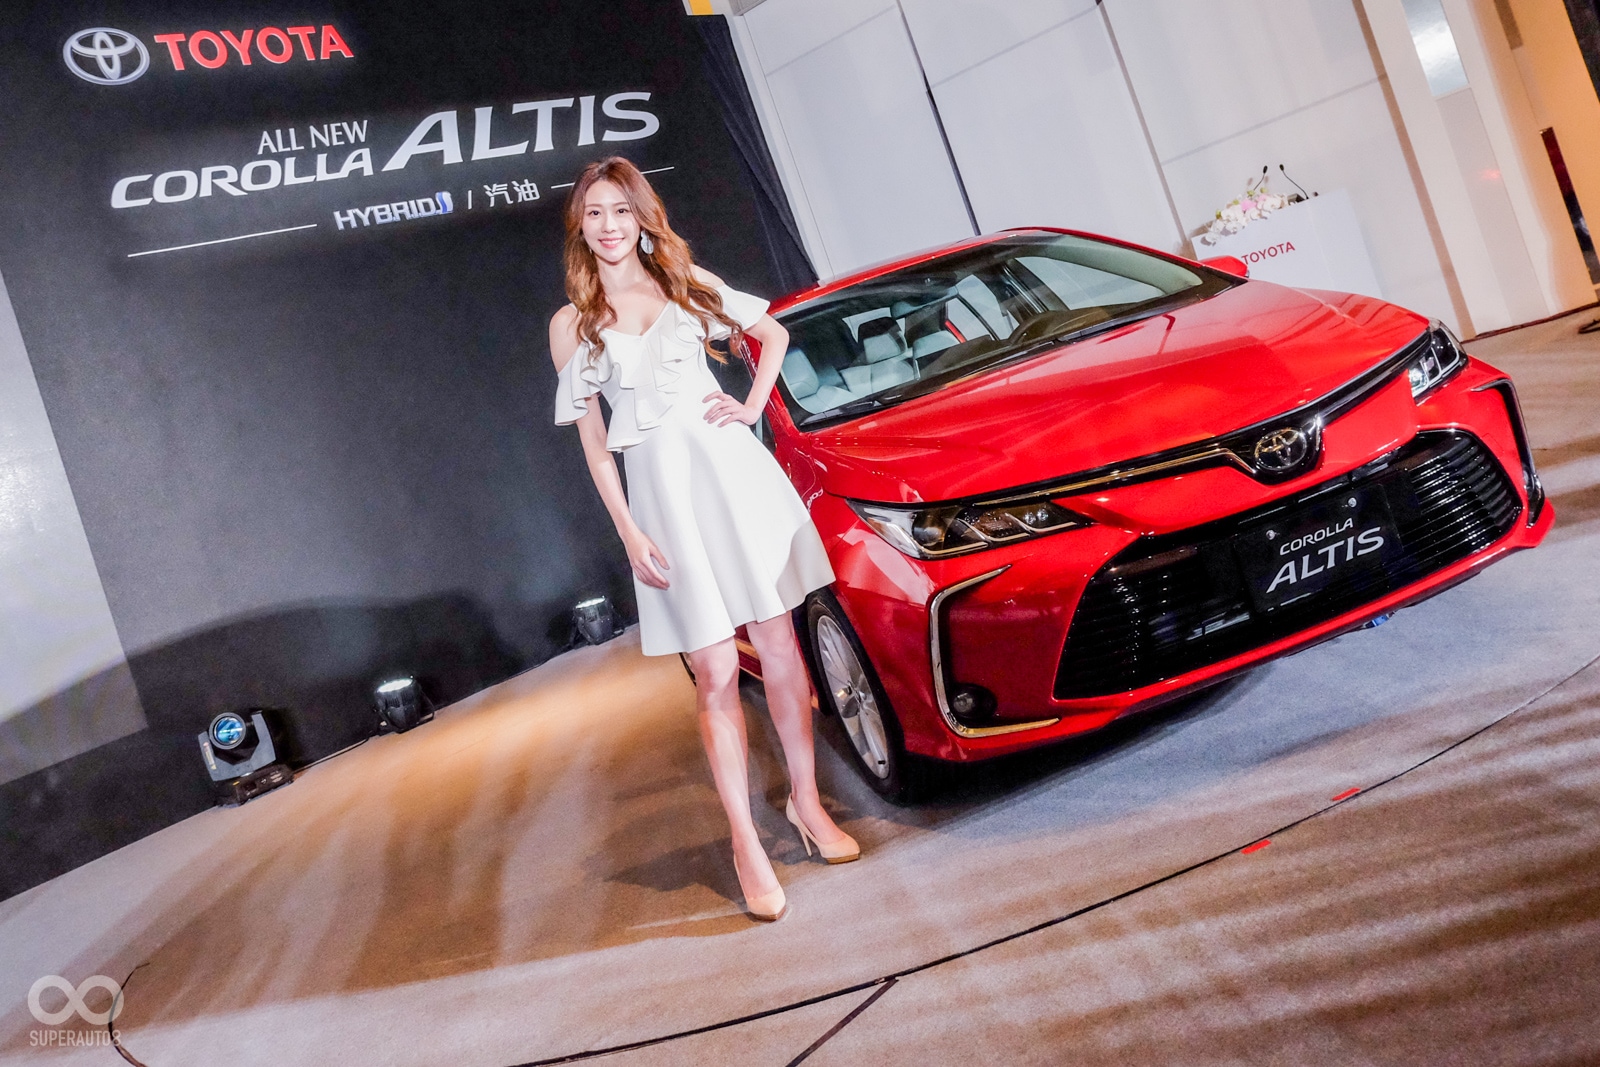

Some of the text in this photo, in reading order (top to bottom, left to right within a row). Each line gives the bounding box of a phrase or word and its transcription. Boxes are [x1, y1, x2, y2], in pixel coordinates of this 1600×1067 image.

[154, 25, 354, 71] TOYOTA
[110, 92, 660, 209] COROLLA ALTIS
[257, 120, 369, 155] ALL NEW
[333, 197, 440, 231] HYBRID
[483, 179, 541, 208] 汽油
[1241, 241, 1296, 265] TOYOTA
[1266, 526, 1385, 594] ALTIS
[1279, 518, 1353, 556] COROLLA
